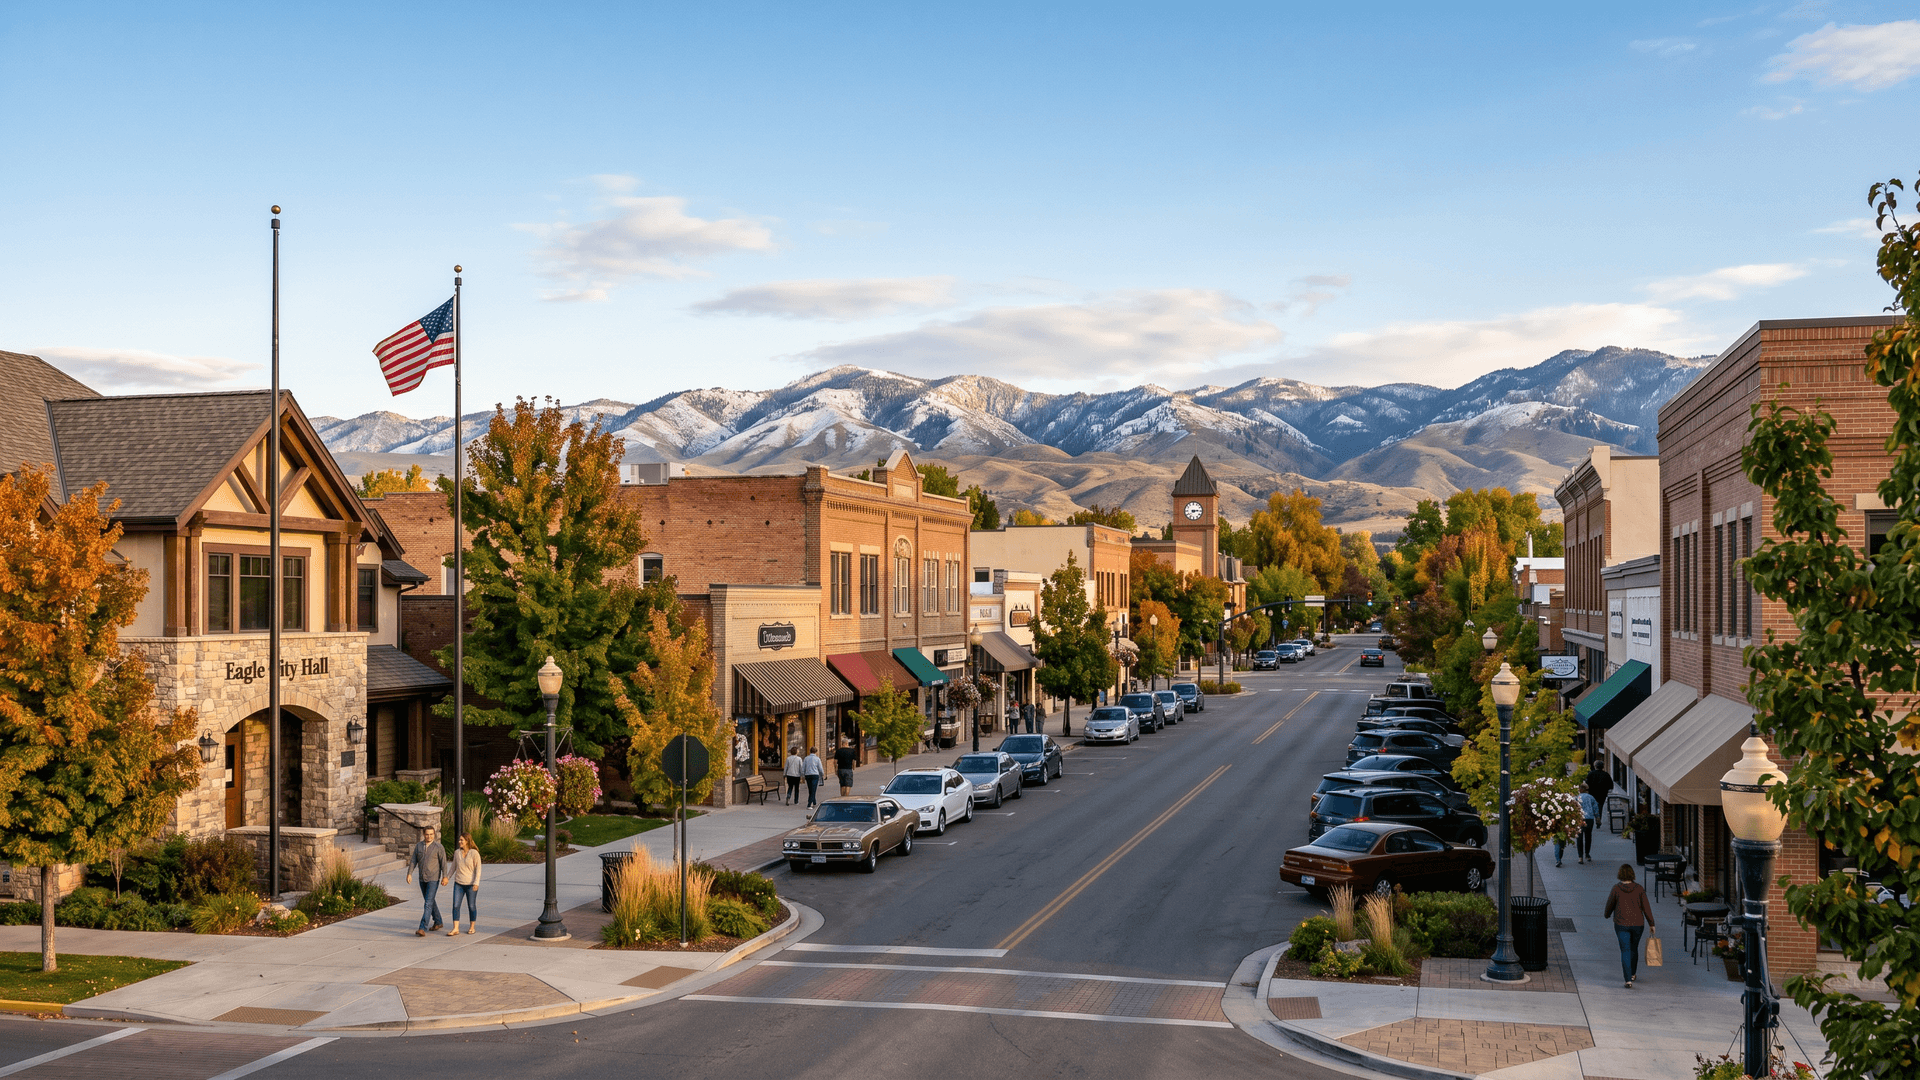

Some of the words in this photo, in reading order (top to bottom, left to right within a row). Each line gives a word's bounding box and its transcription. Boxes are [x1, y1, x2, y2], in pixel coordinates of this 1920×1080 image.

[225, 661, 265, 684] Eagle
[268, 659, 298, 681] ity
[301, 657, 328, 676] Hall
